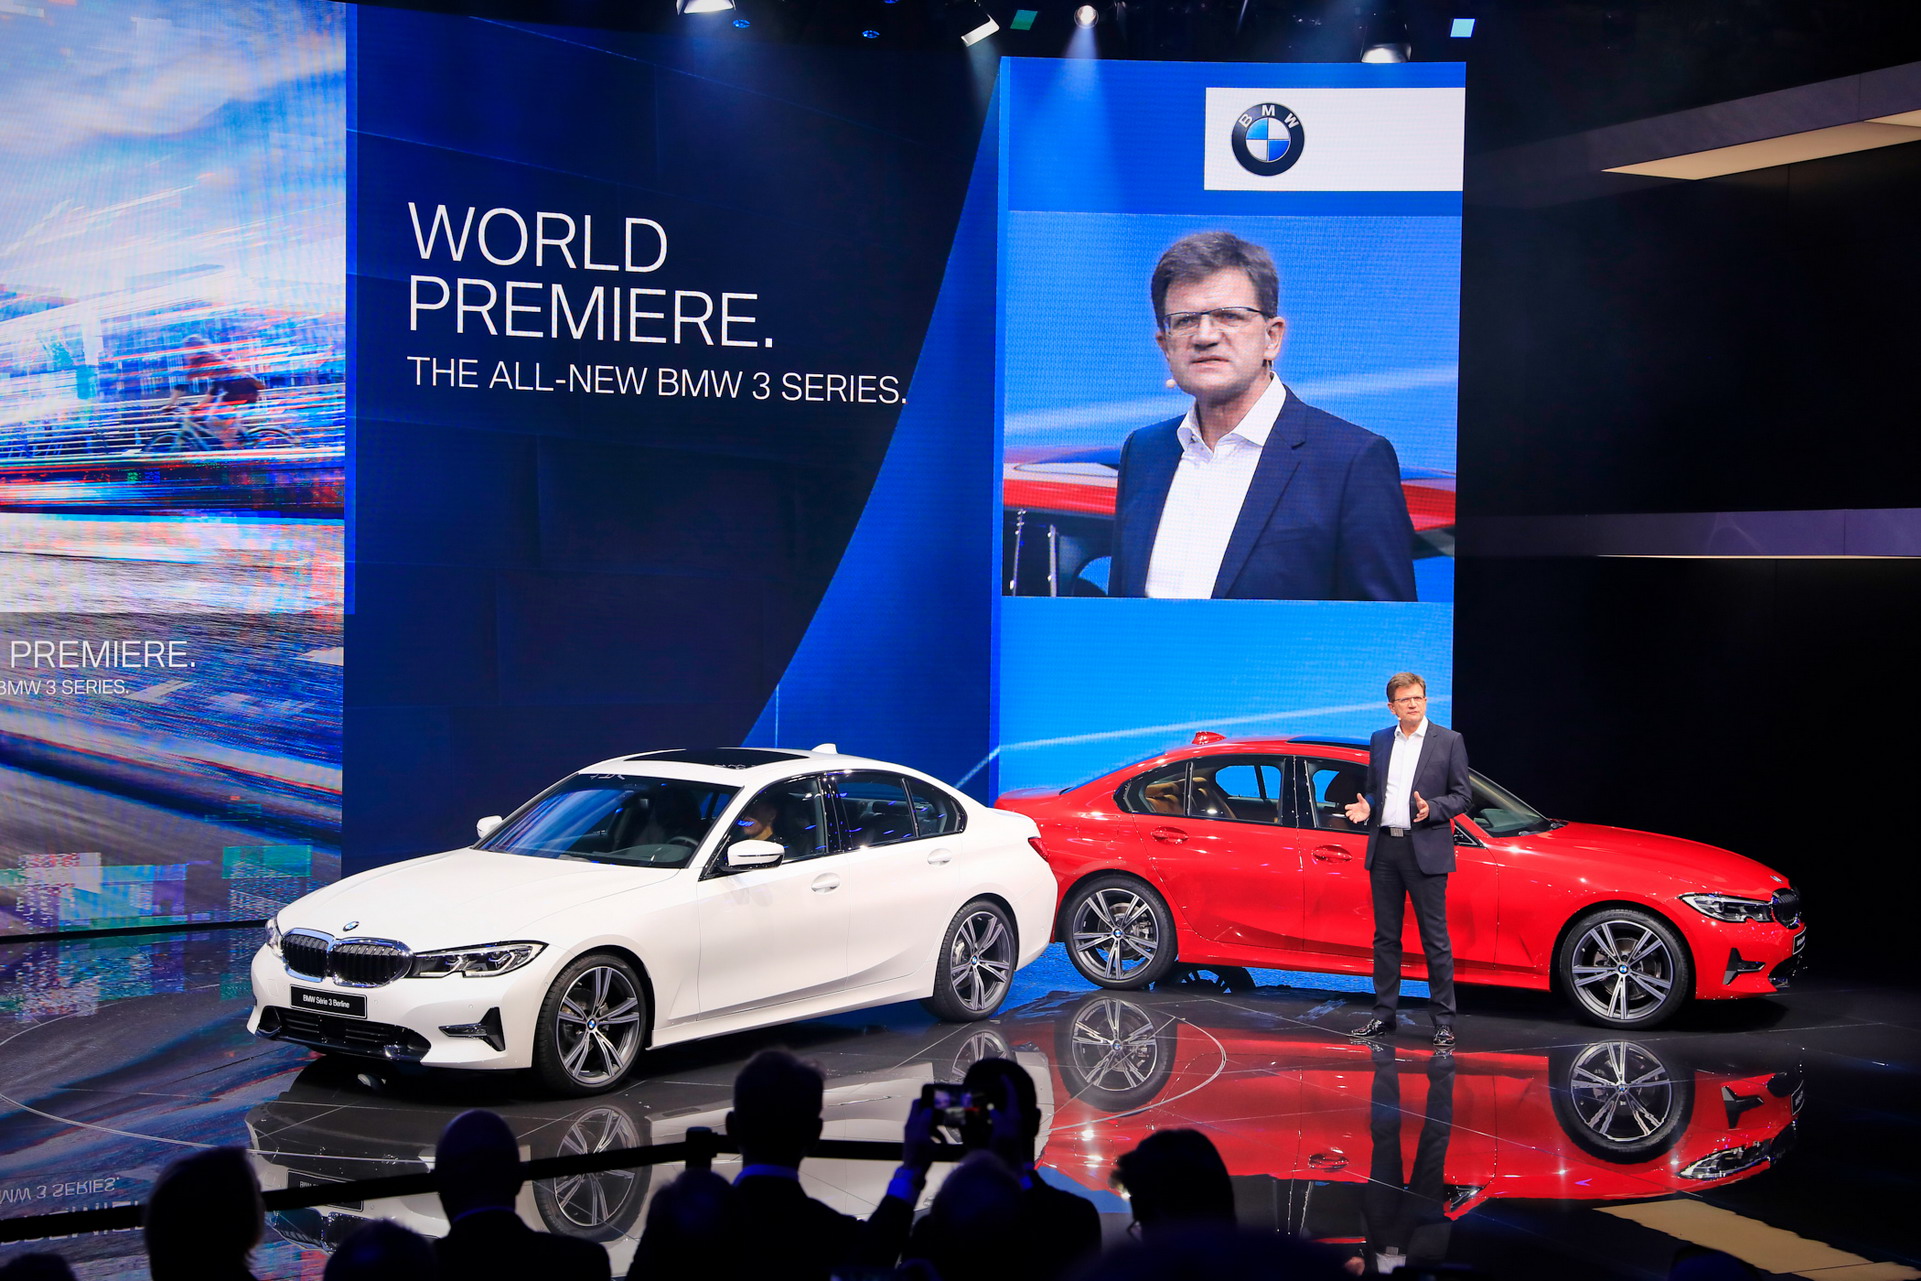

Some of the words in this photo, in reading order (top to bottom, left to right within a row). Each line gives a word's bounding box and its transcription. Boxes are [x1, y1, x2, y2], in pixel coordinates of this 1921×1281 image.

[1238, 104, 1300, 129] BMW
[408, 202, 668, 273] WORLD
[409, 274, 773, 348] PREMIERE.
[407, 356, 479, 388] THE
[489, 360, 648, 395] ALL-NEW
[658, 367, 743, 399] BMW
[752, 371, 771, 400] 3
[781, 372, 907, 404] SERIES.
[10, 640, 196, 668] PREMIERE.
[46, 679, 56, 695] 3
[62, 679, 129, 695] SERIES.
[303, 994, 316, 1003] BMW
[333, 999, 350, 1008] Berline
